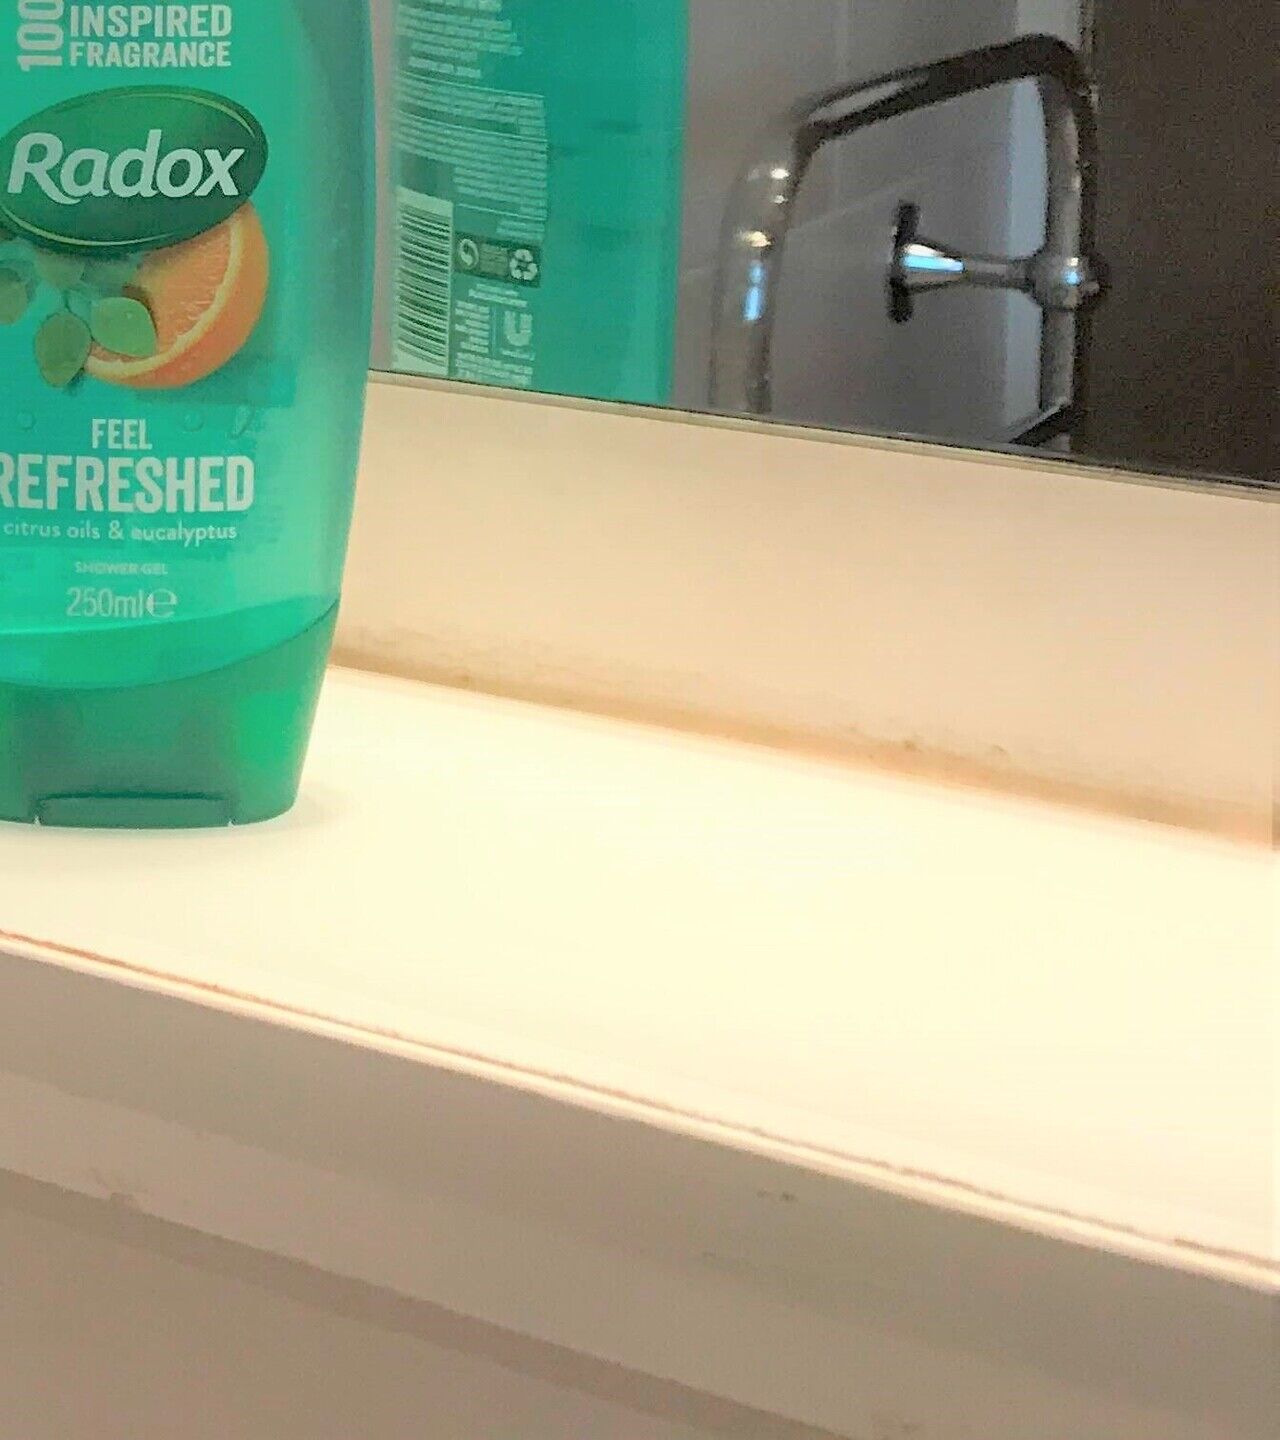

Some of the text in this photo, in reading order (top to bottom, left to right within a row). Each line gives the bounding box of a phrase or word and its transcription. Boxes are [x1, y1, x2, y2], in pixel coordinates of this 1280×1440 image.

[69, 4, 232, 38] INSPIRED
[68, 40, 233, 69] FRAGRANCE
[6, 128, 246, 205] Radox
[91, 418, 153, 450] FEEL
[3, 519, 238, 548] citrus oils & eucalyptus
